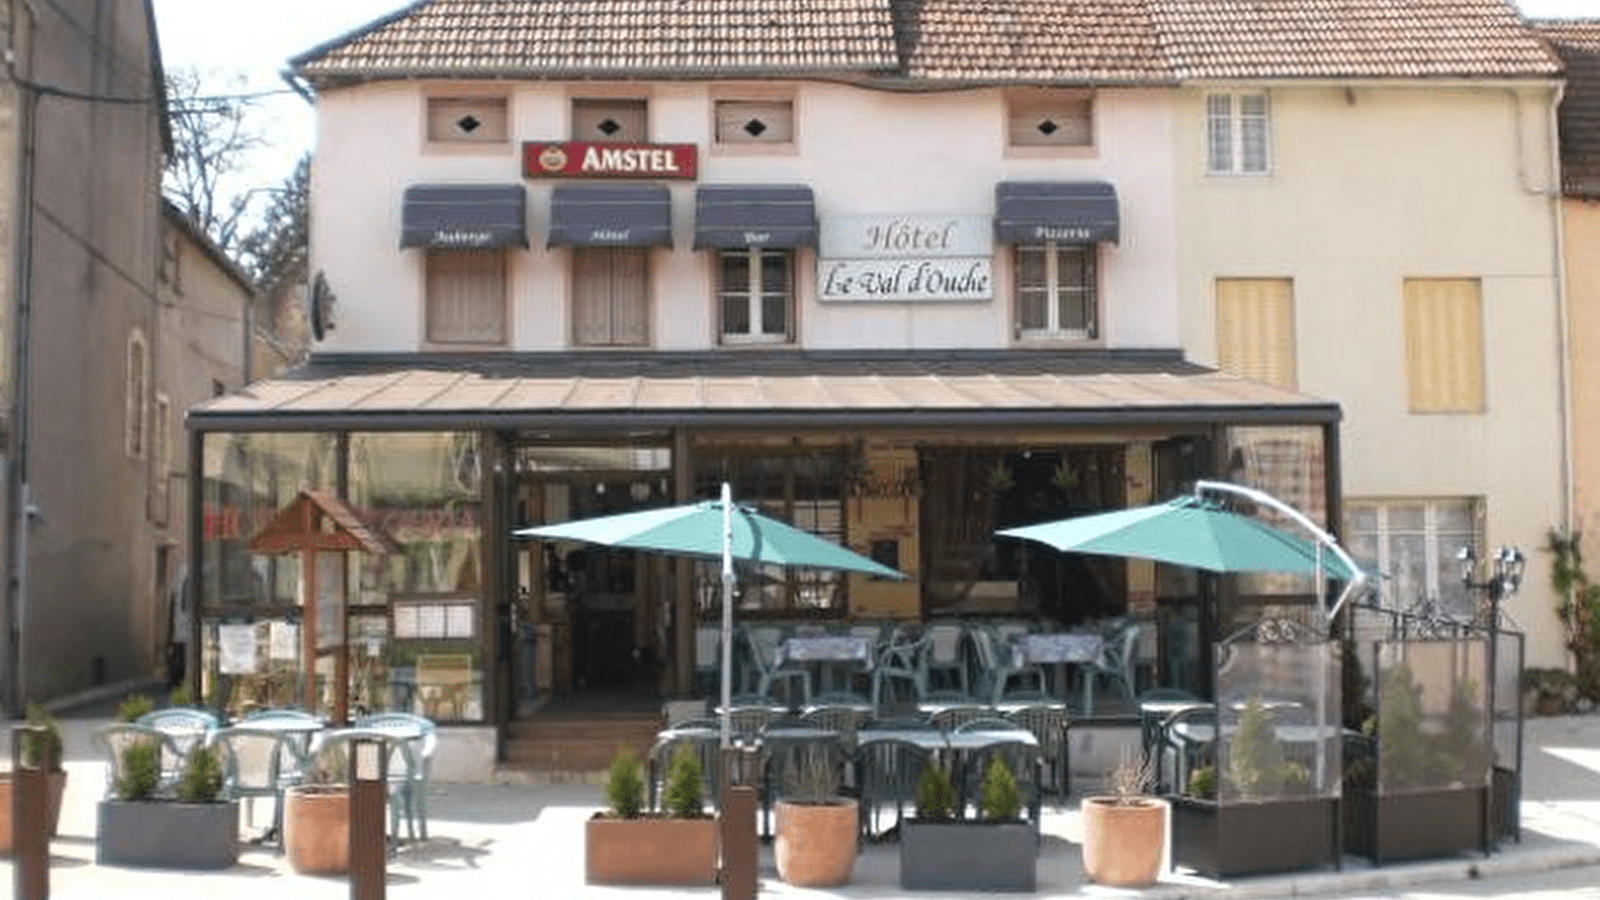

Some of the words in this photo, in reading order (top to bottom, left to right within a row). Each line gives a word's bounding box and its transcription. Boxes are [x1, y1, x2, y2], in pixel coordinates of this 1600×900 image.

[581, 146, 680, 172] AMSTEL
[863, 219, 958, 249] Hôtel
[823, 262, 853, 295] Le
[860, 263, 908, 294] Val
[908, 261, 988, 294] d'Ouche
